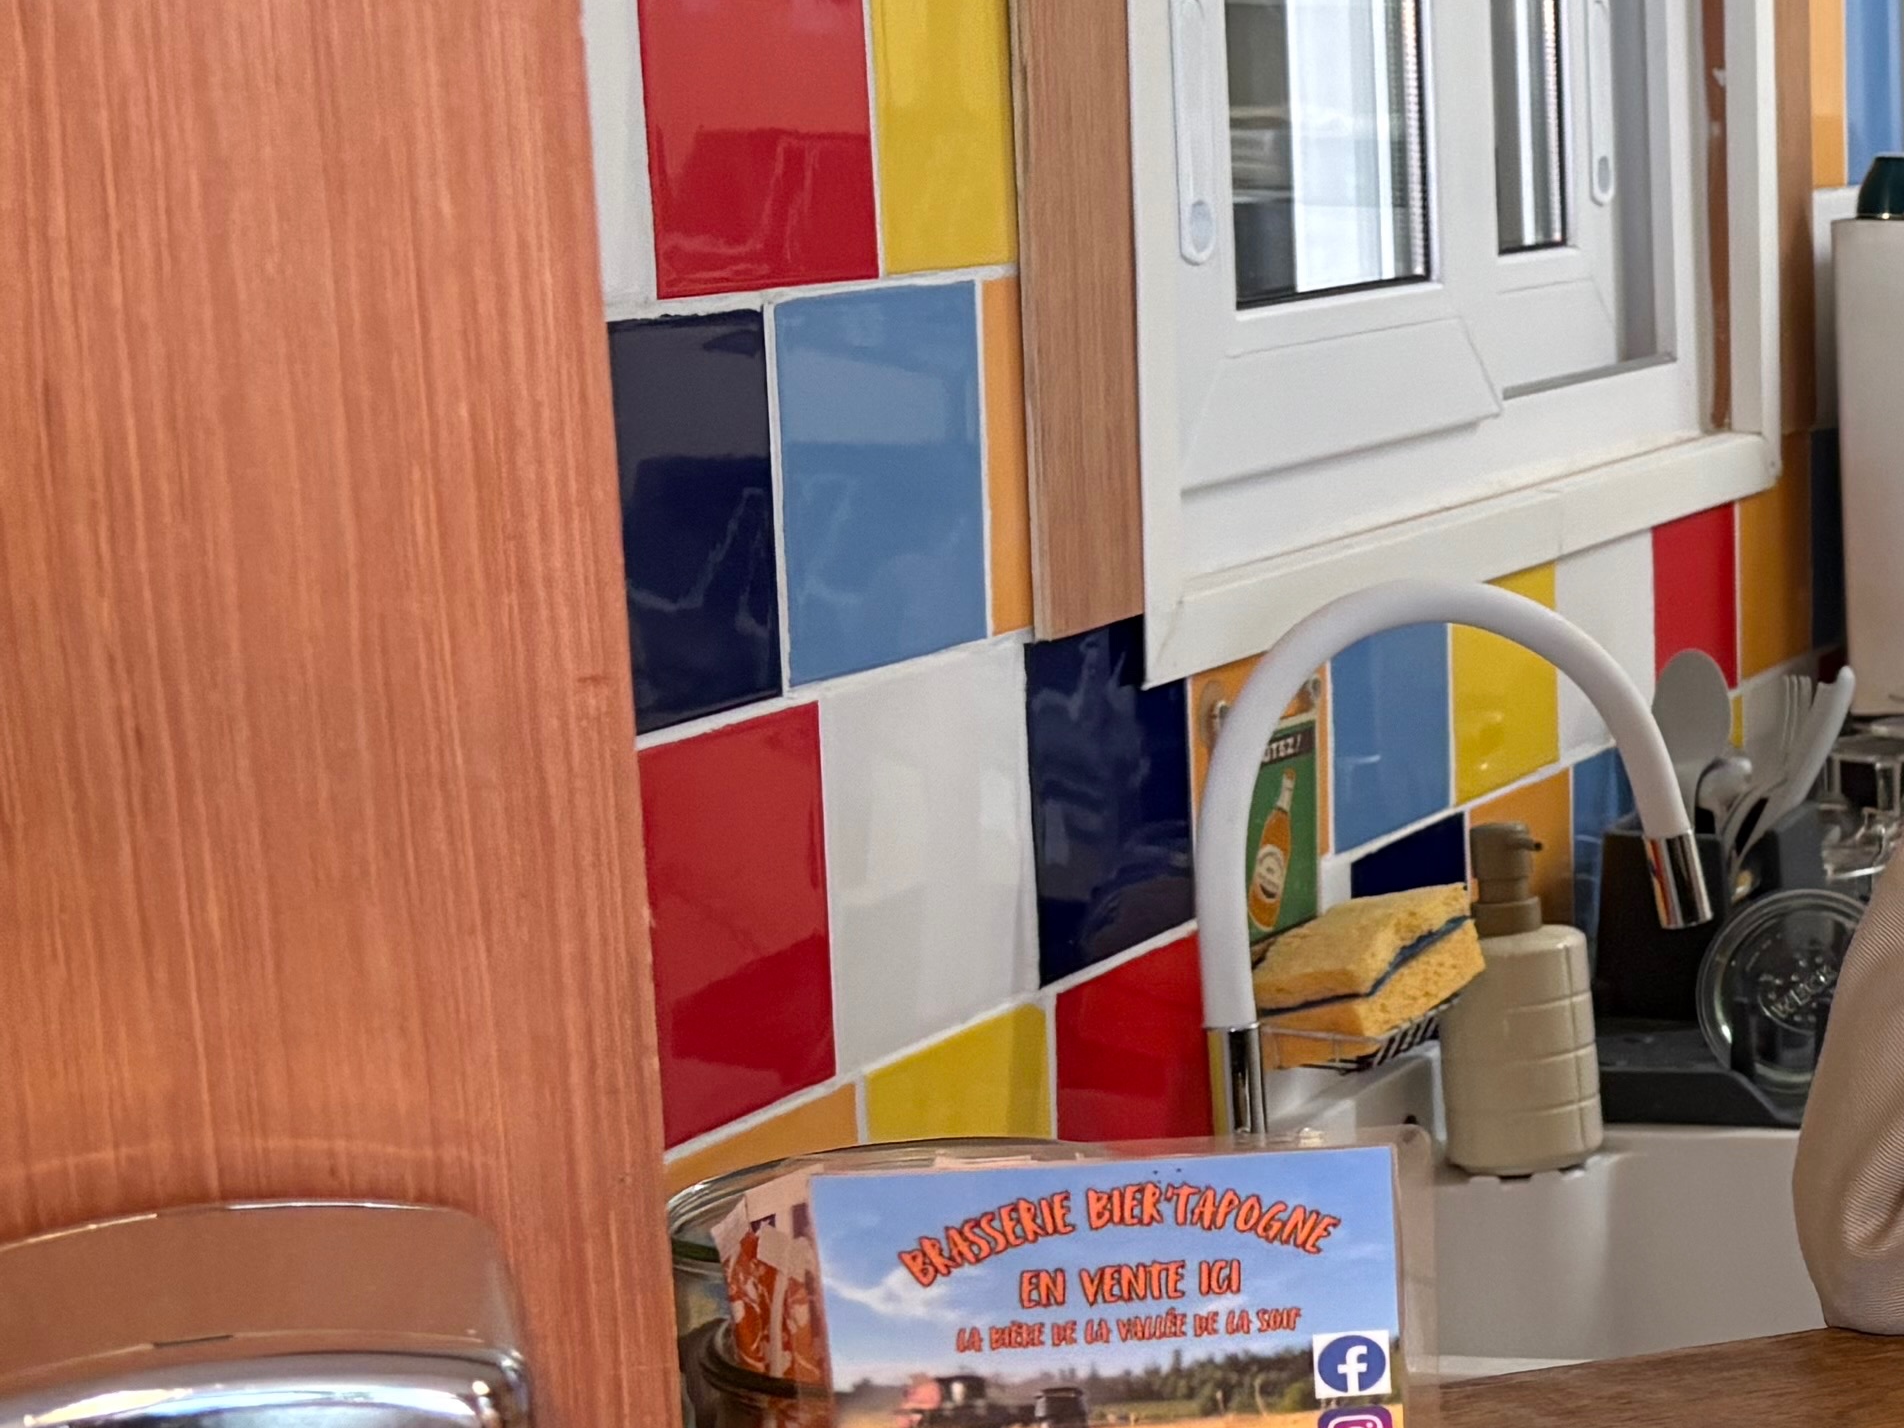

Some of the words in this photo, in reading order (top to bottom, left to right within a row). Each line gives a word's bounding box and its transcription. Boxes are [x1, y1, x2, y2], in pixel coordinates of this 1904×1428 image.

[899, 1189, 1074, 1287] BRASSERIE
[1086, 1182, 1342, 1255] BIER'TAPOGNE
[1019, 1267, 1066, 1308] EN
[1079, 1260, 1186, 1306] VENTE
[1199, 1259, 1242, 1296] ICI
[955, 1327, 984, 1354] LA
[989, 1321, 1046, 1350] BIÈRE
[1052, 1320, 1077, 1346] DE
[1084, 1318, 1112, 1344] LA
[1117, 1307, 1188, 1342] VALLÉE
[1194, 1311, 1219, 1337] DE
[1225, 1310, 1252, 1334] LA
[1256, 1307, 1303, 1332] SOIF
